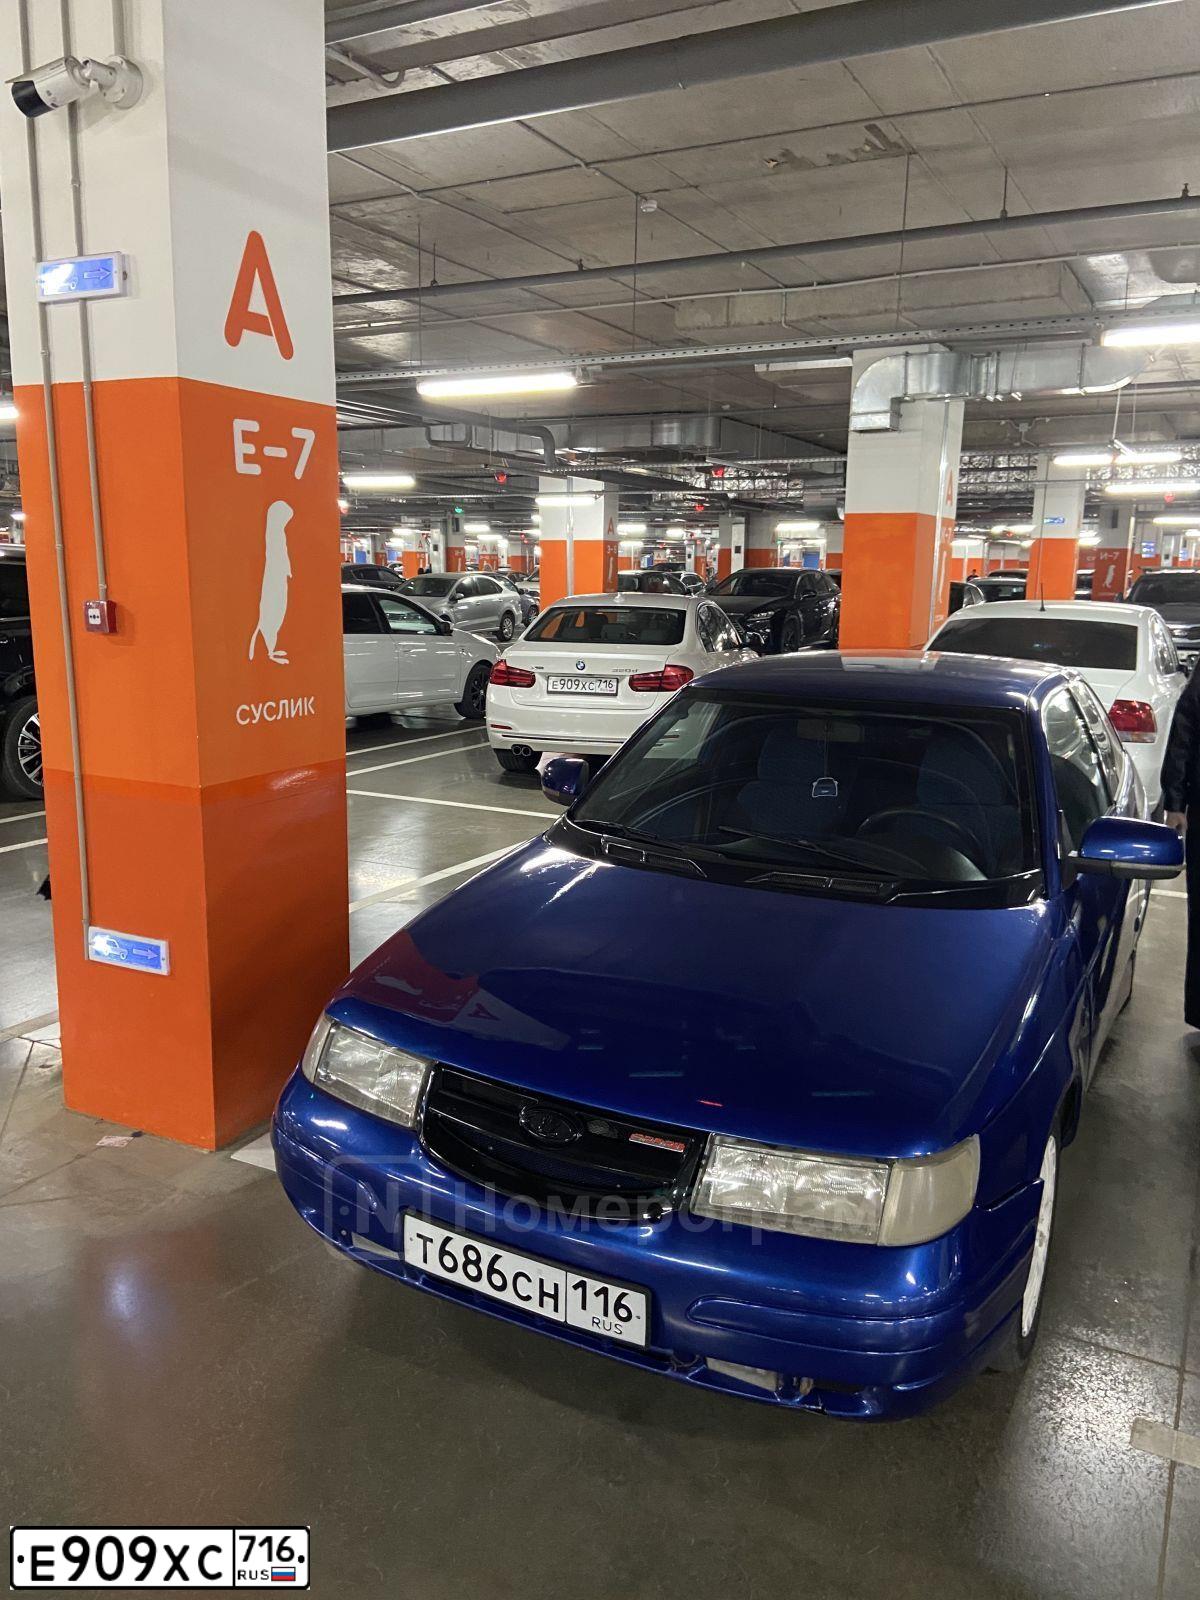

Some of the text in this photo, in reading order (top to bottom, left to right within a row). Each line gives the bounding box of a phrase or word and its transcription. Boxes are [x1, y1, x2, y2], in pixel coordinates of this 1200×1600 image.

[224, 230, 294, 360] А
[233, 418, 315, 480] Е-7
[596, 679, 614, 689] 716
[236, 696, 315, 725] СУСЛИК
[416, 1233, 632, 1322] Т686СН 116
[592, 1316, 623, 1335] RUS
